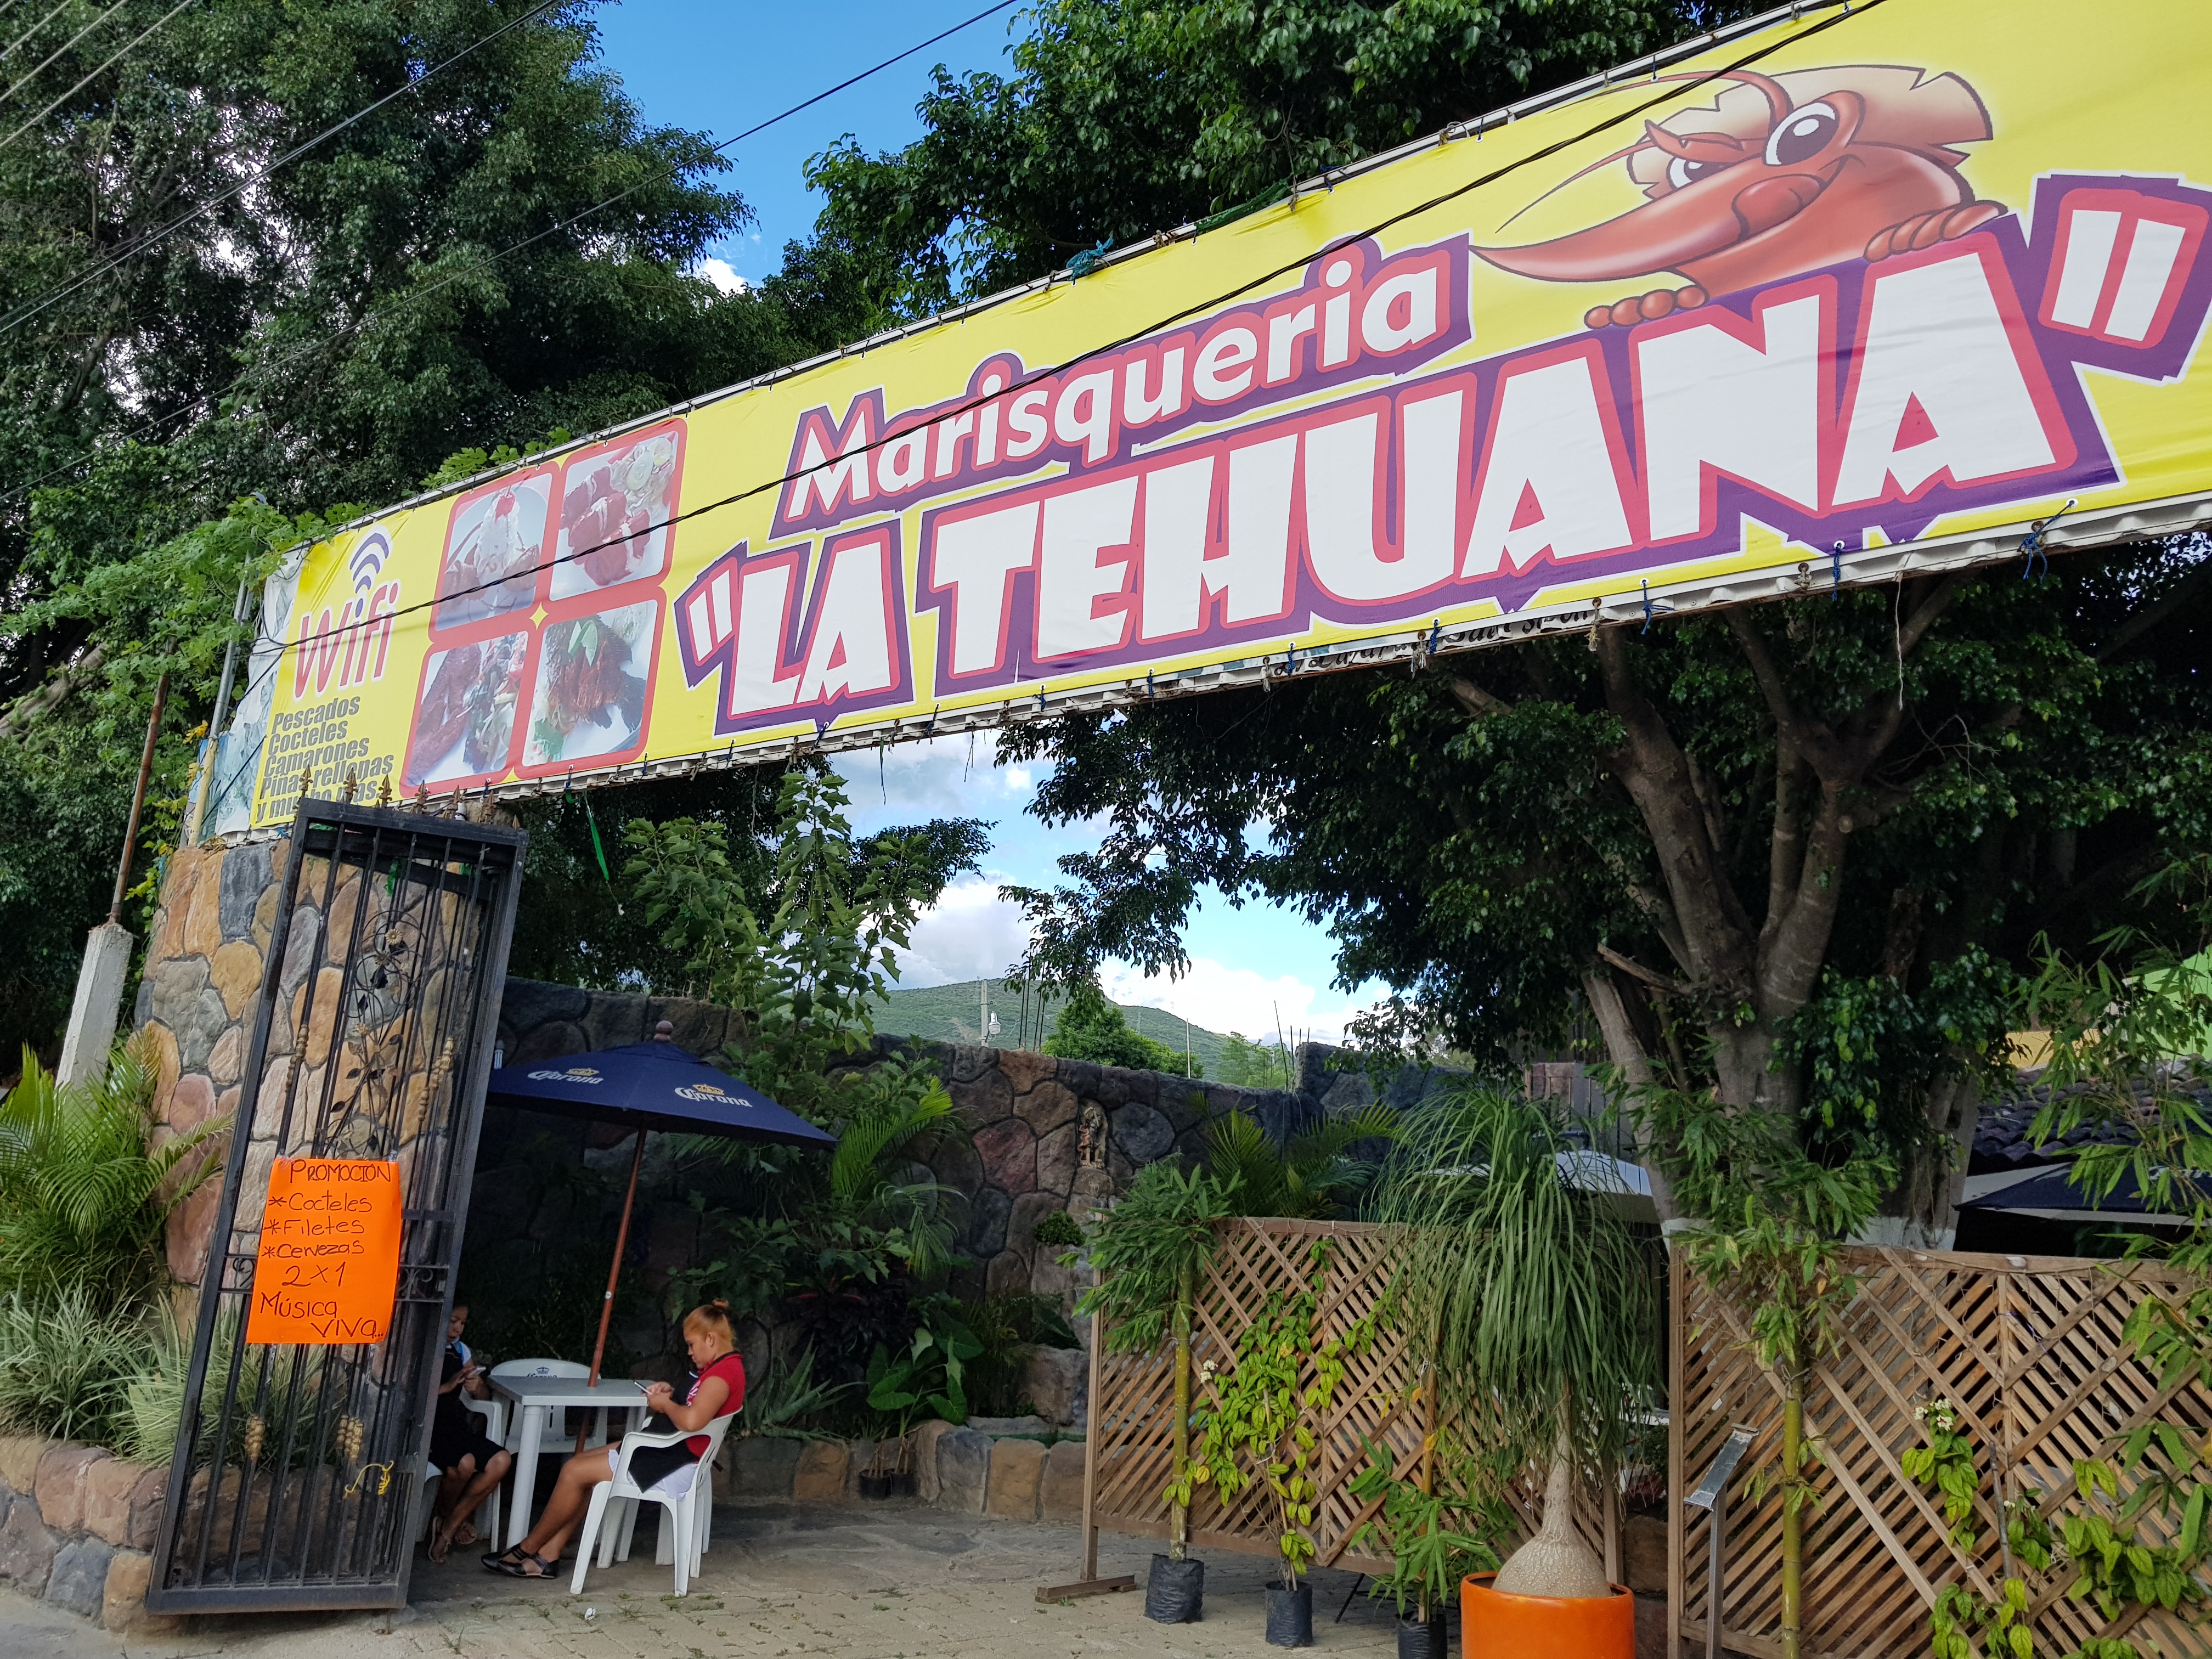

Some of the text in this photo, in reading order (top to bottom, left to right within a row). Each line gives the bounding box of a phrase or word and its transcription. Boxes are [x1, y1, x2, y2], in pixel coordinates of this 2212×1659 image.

[787, 258, 1437, 518] Marisqueria
[295, 583, 398, 698] Wifi
[272, 696, 360, 735] Pescados
[268, 720, 348, 756] Cocteles
[264, 738, 370, 777] Camarones
[313, 754, 394, 788] rellenas
[256, 802, 267, 823] y
[527, 1070, 604, 1084] Corona
[674, 1087, 753, 1107] Corona
[290, 1159, 391, 1183] PROMOCION
[260, 1291, 337, 1319] Música
